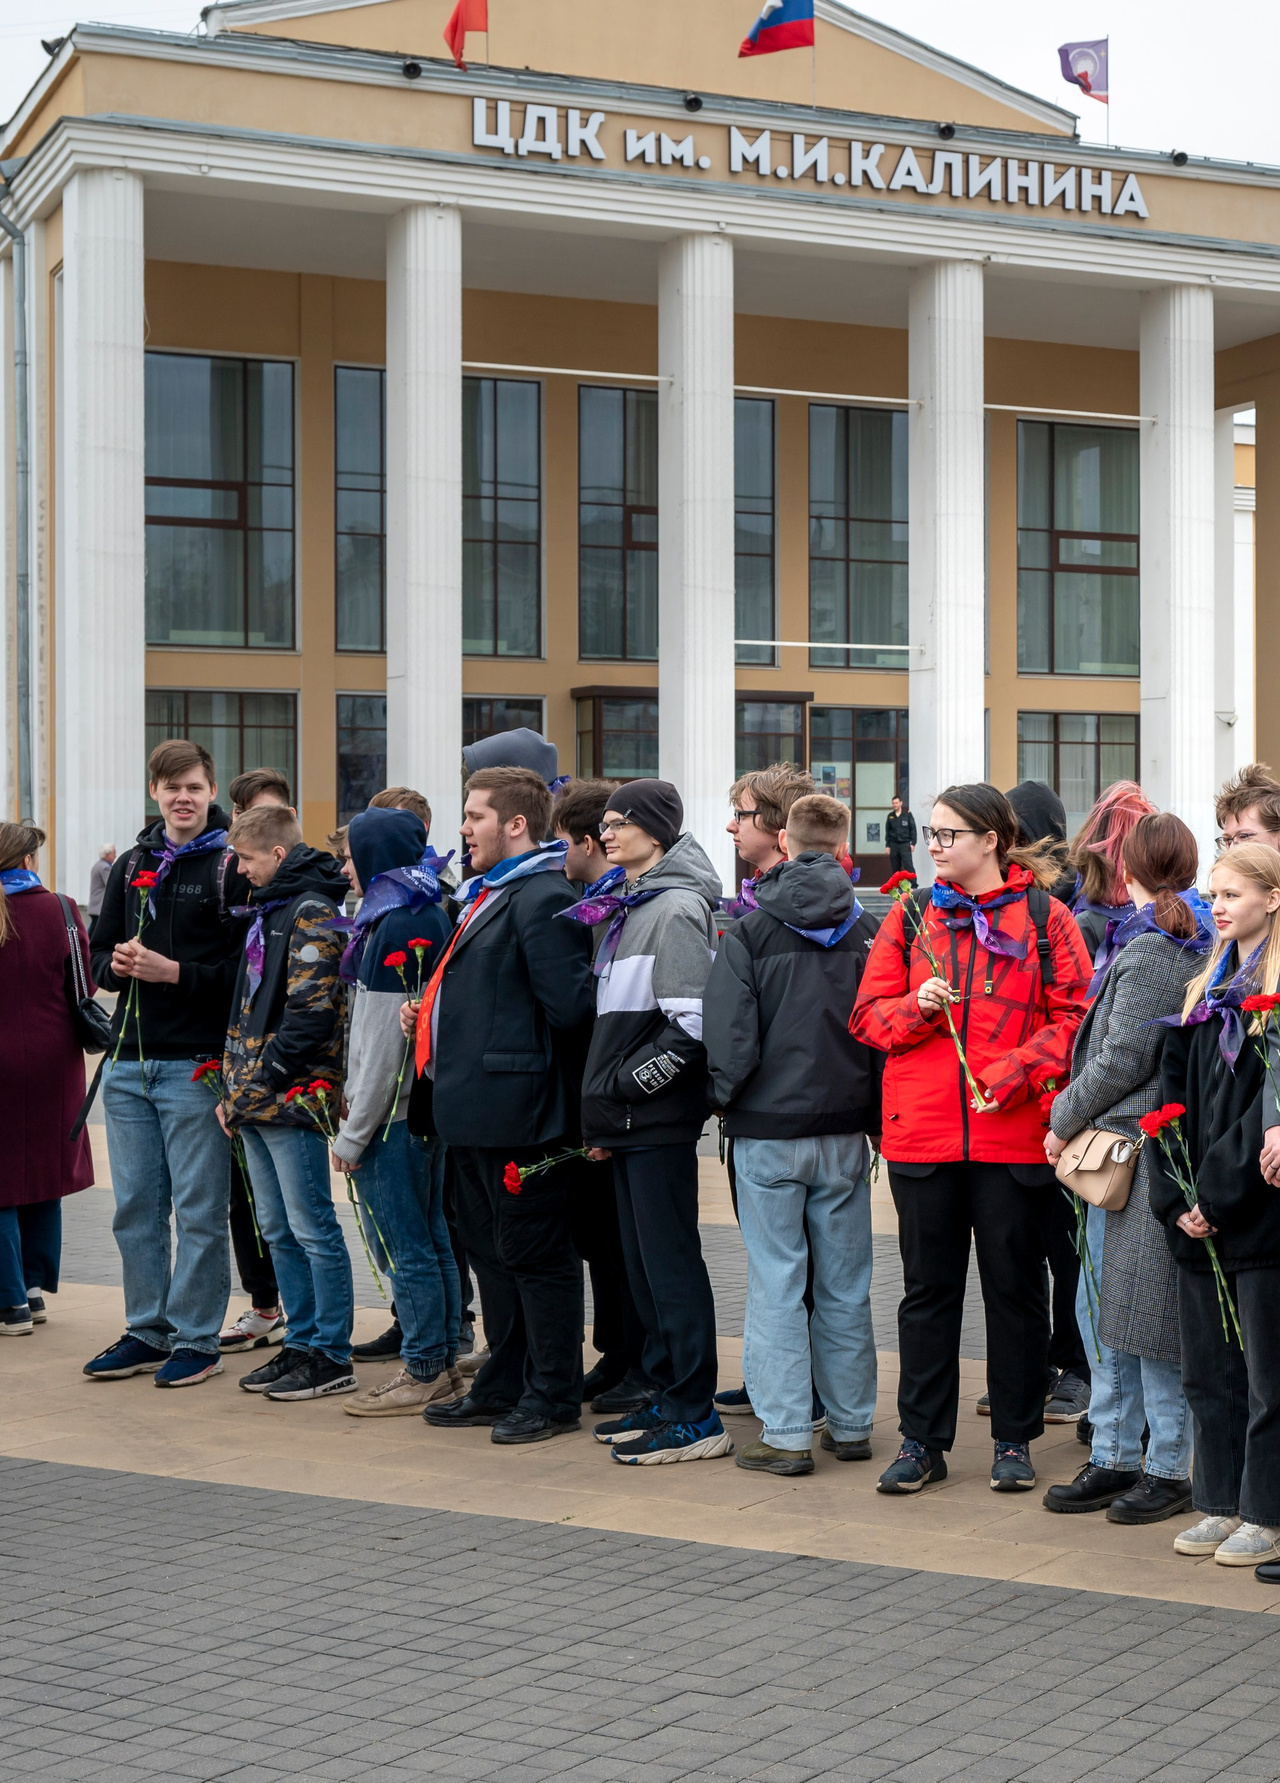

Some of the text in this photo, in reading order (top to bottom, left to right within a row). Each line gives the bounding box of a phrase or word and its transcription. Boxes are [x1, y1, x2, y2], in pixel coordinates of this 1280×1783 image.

[472, 97, 606, 160] ЦДК
[625, 128, 711, 170] им.
[172, 883, 202, 895] 1968
